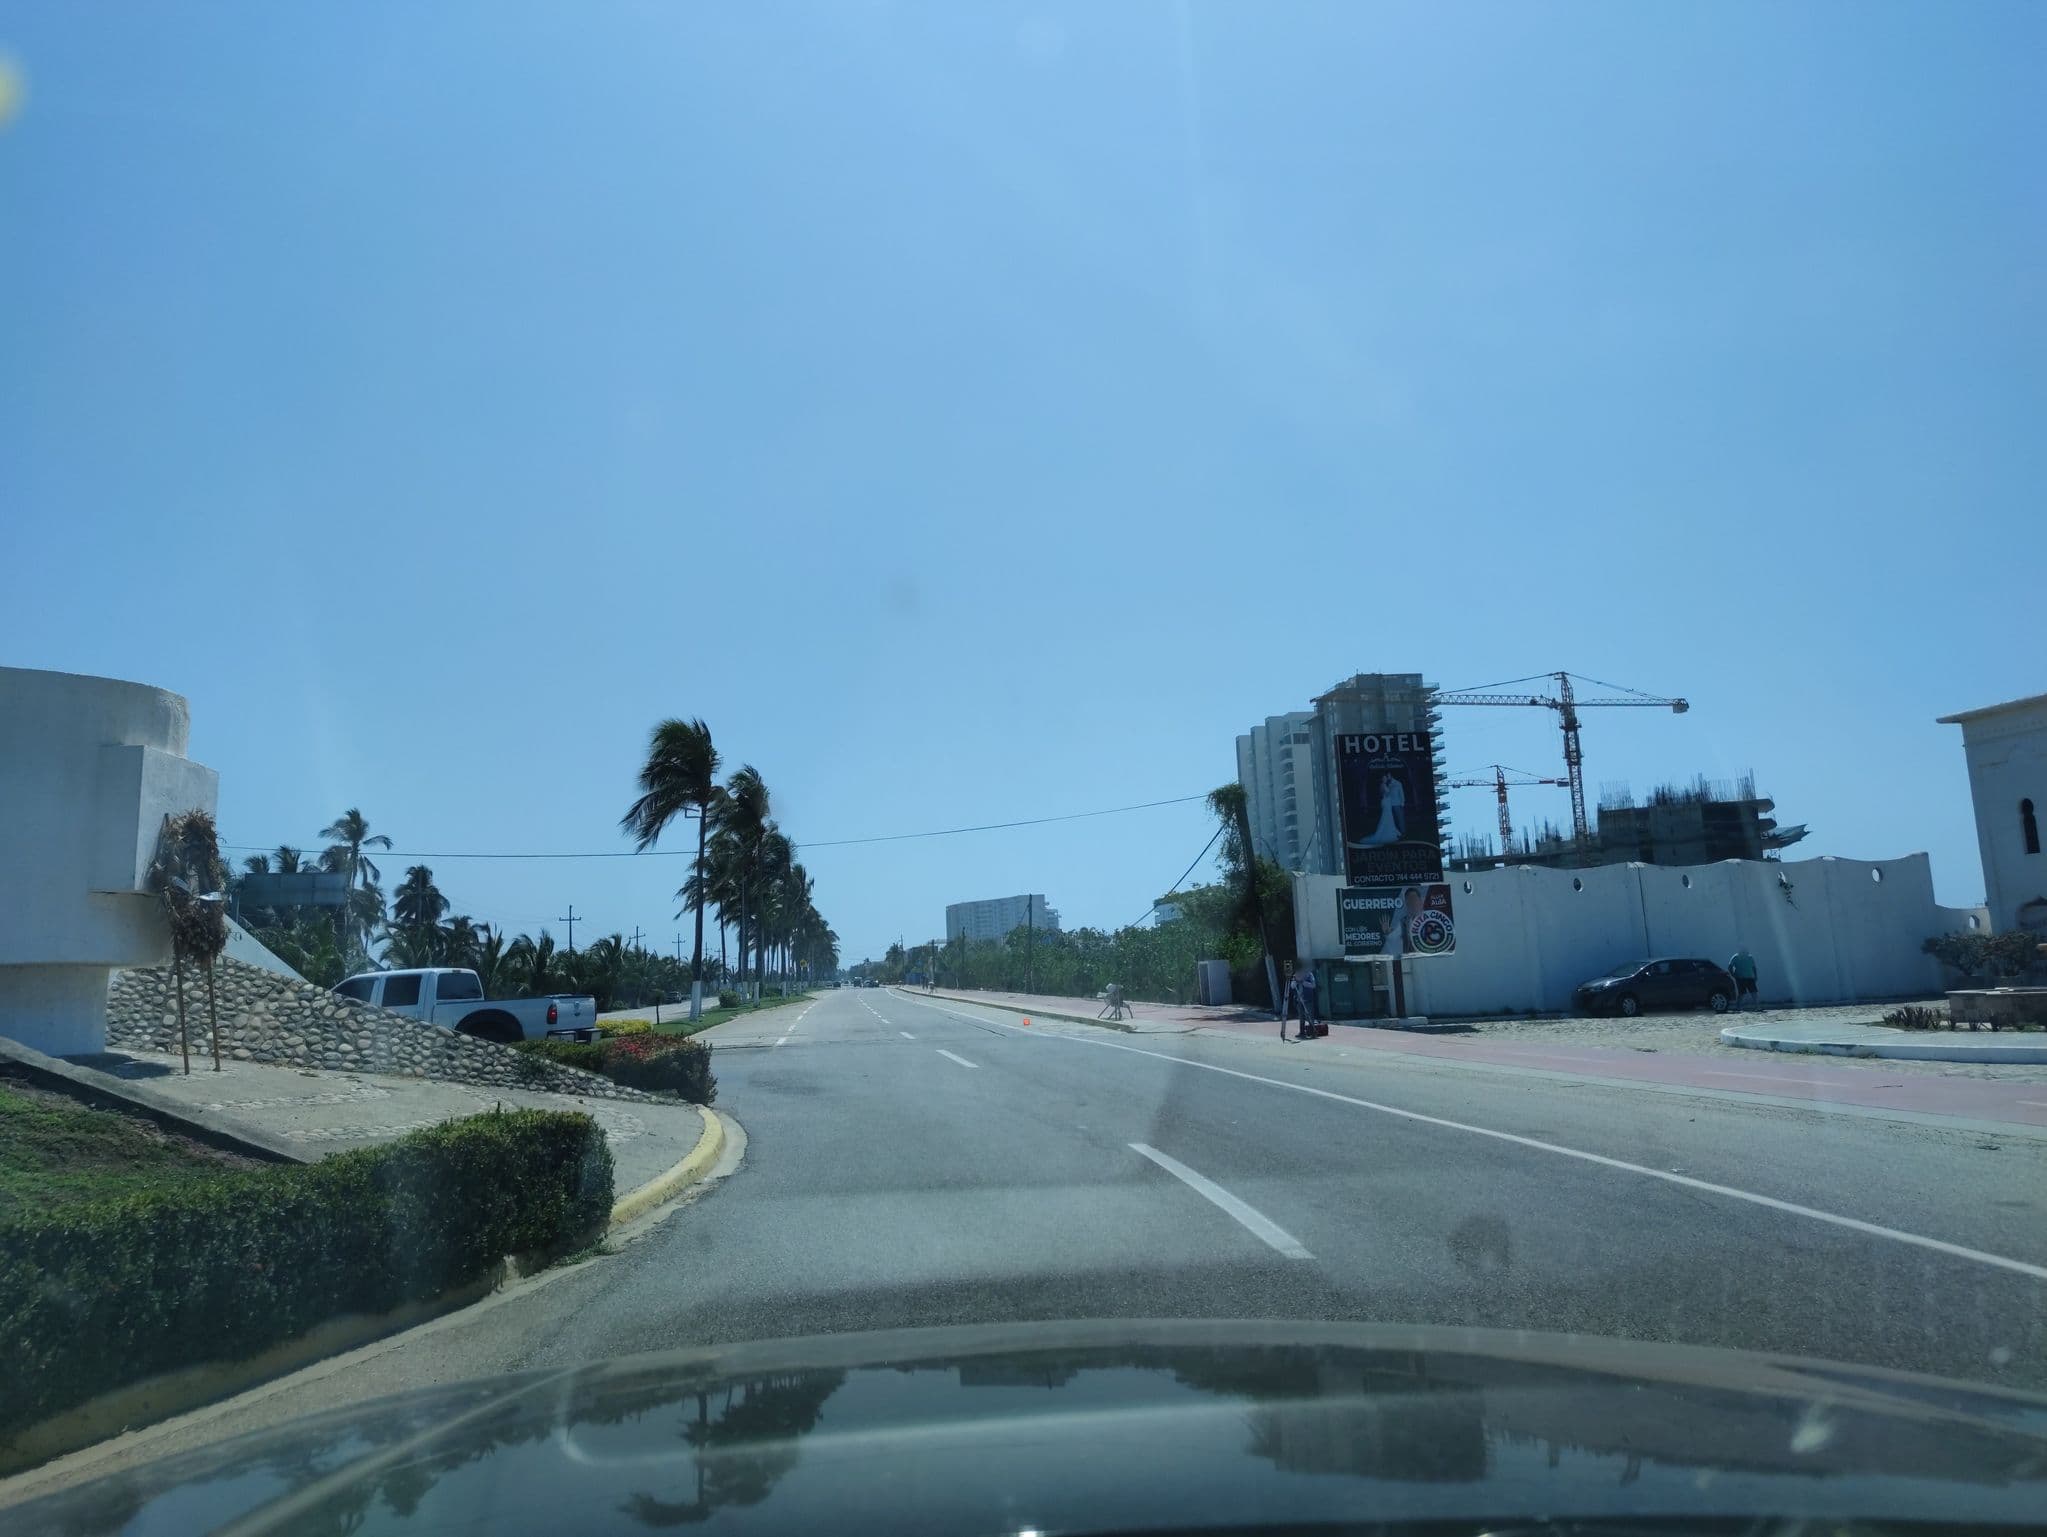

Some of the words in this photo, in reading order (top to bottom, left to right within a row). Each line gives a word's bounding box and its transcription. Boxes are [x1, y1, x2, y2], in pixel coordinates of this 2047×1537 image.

[1344, 734, 1424, 754] HOTEL
[1354, 873, 1395, 883] CONTACTO
[1343, 897, 1403, 910] GUERRERO
[1411, 912, 1429, 934] RUTA
[1430, 911, 1453, 932] CINCO
[1345, 932, 1381, 941] MEJORES
